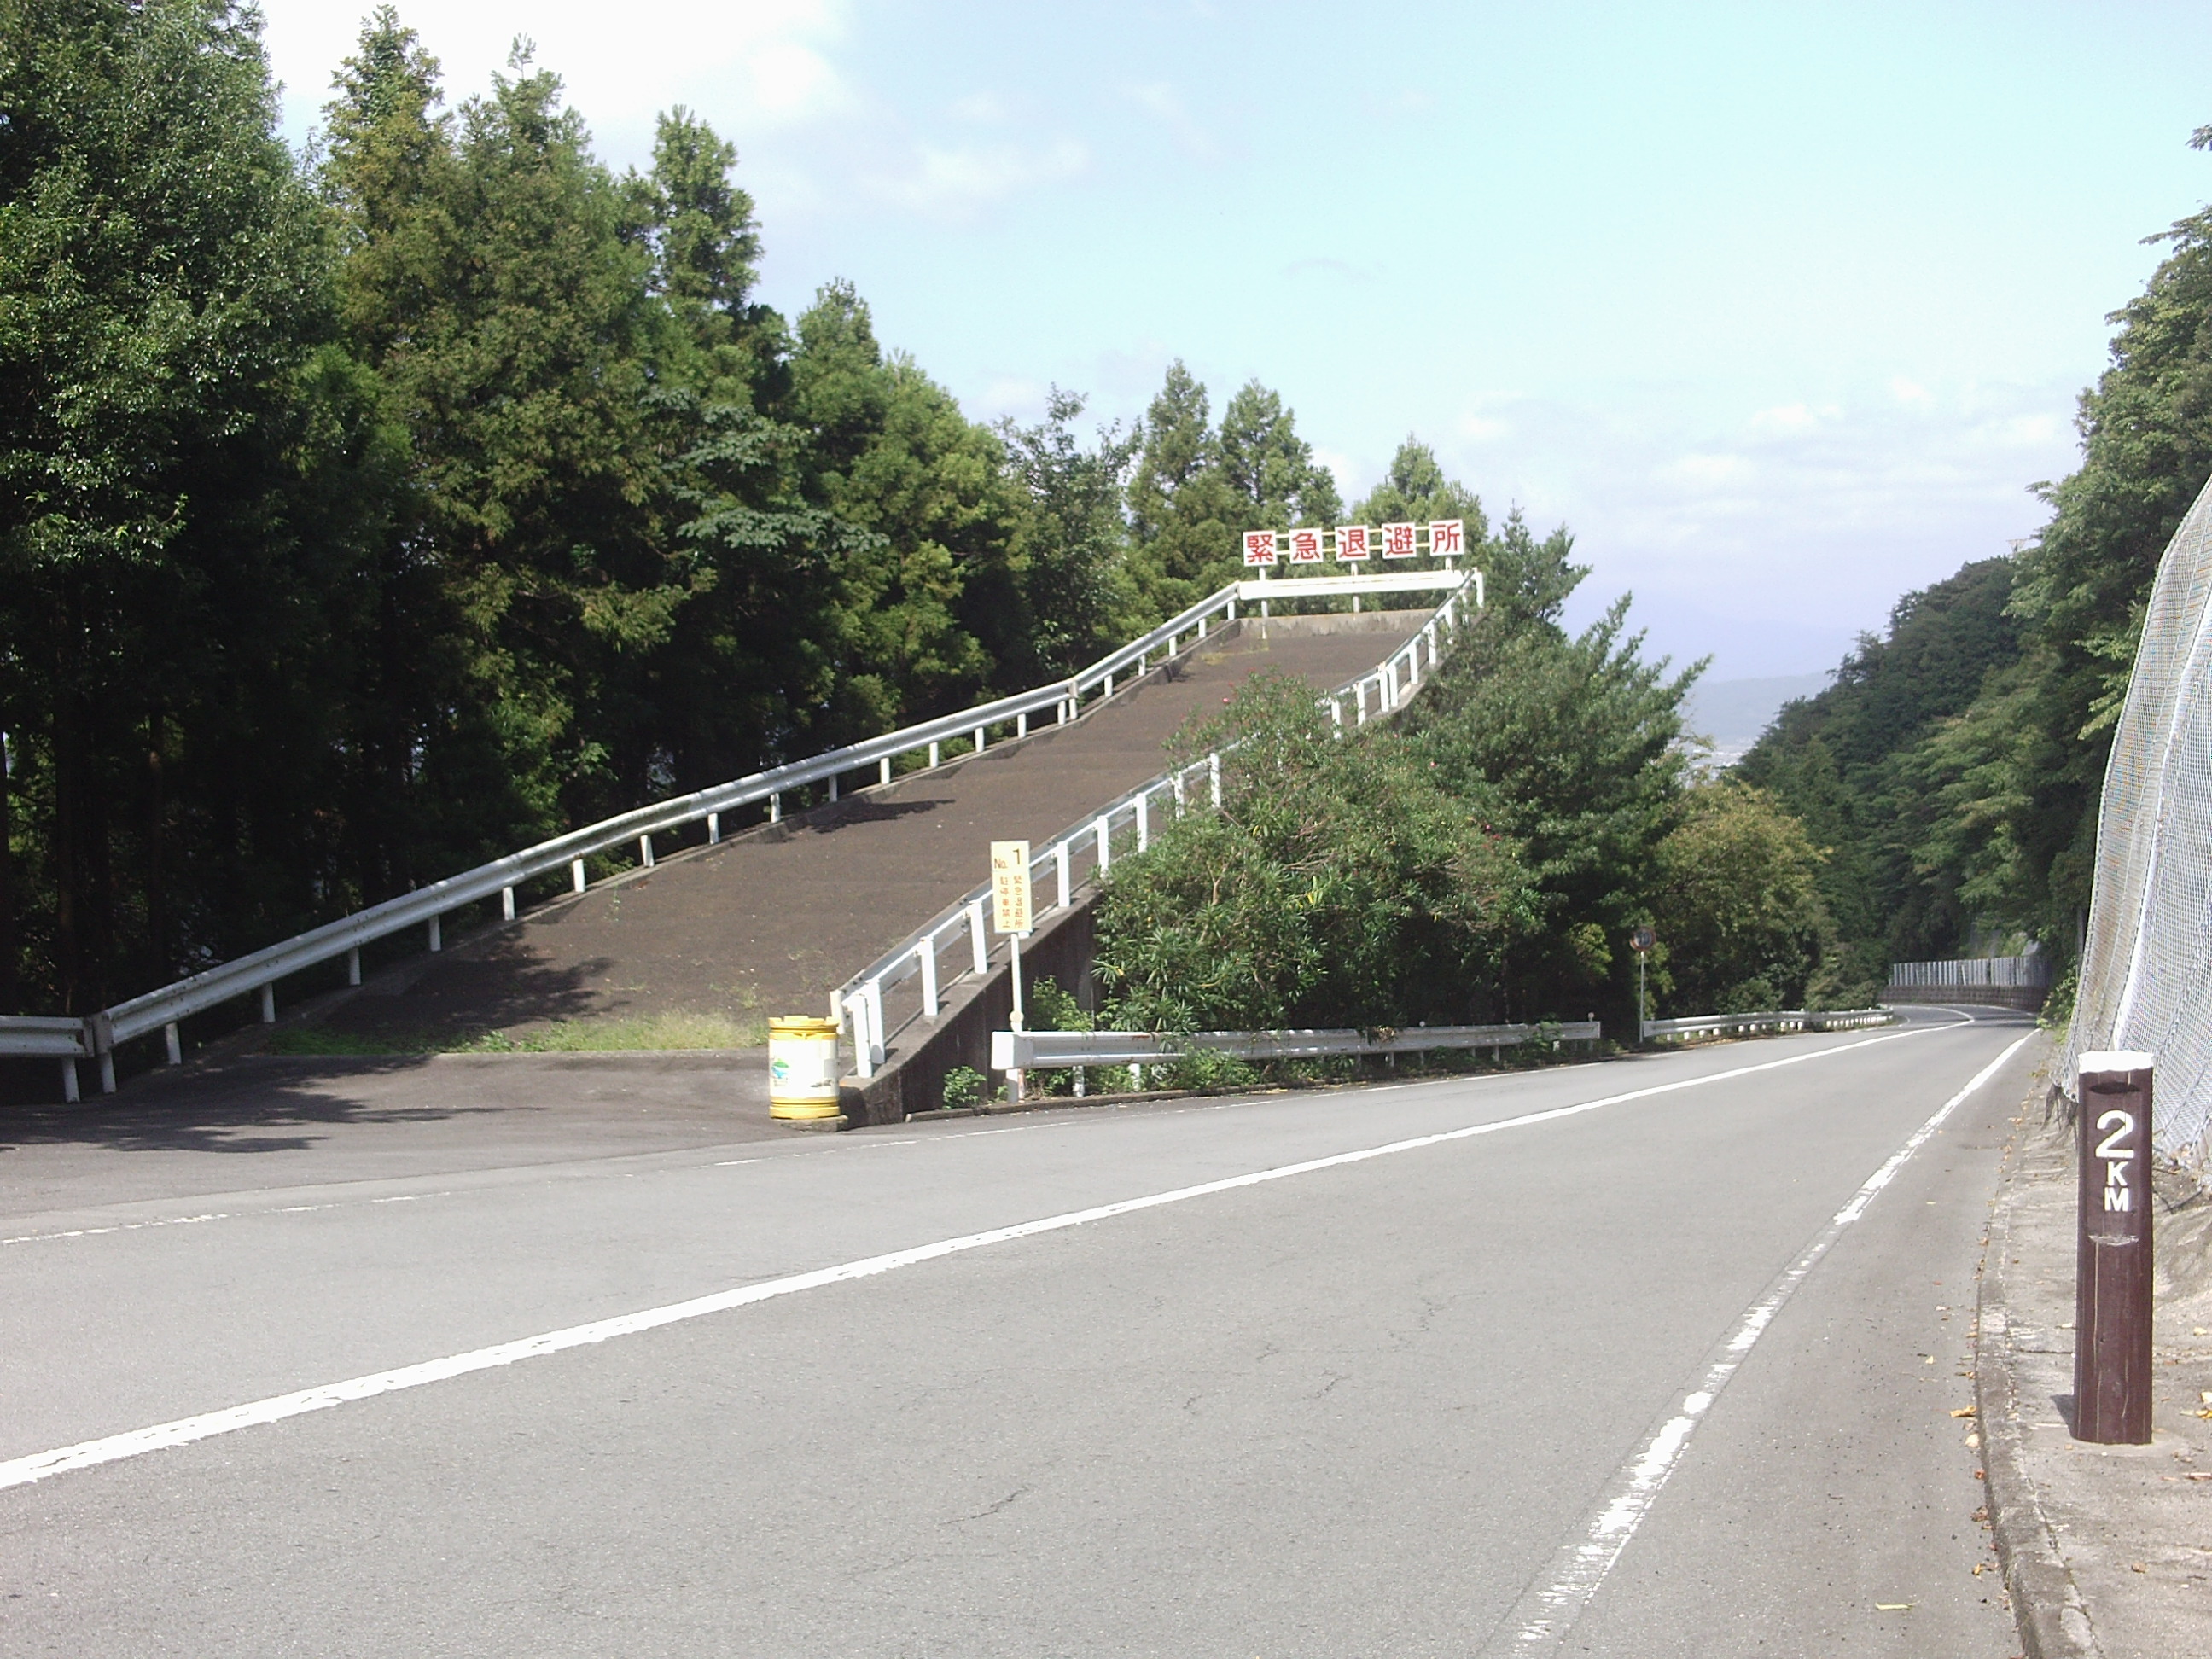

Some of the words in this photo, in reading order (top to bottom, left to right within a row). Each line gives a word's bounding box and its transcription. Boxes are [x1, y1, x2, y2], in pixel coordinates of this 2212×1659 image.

[1247, 522, 1460, 562] 緊急退避所
[1012, 847, 1021, 865] 1
[2095, 1109, 2134, 1158] 2
